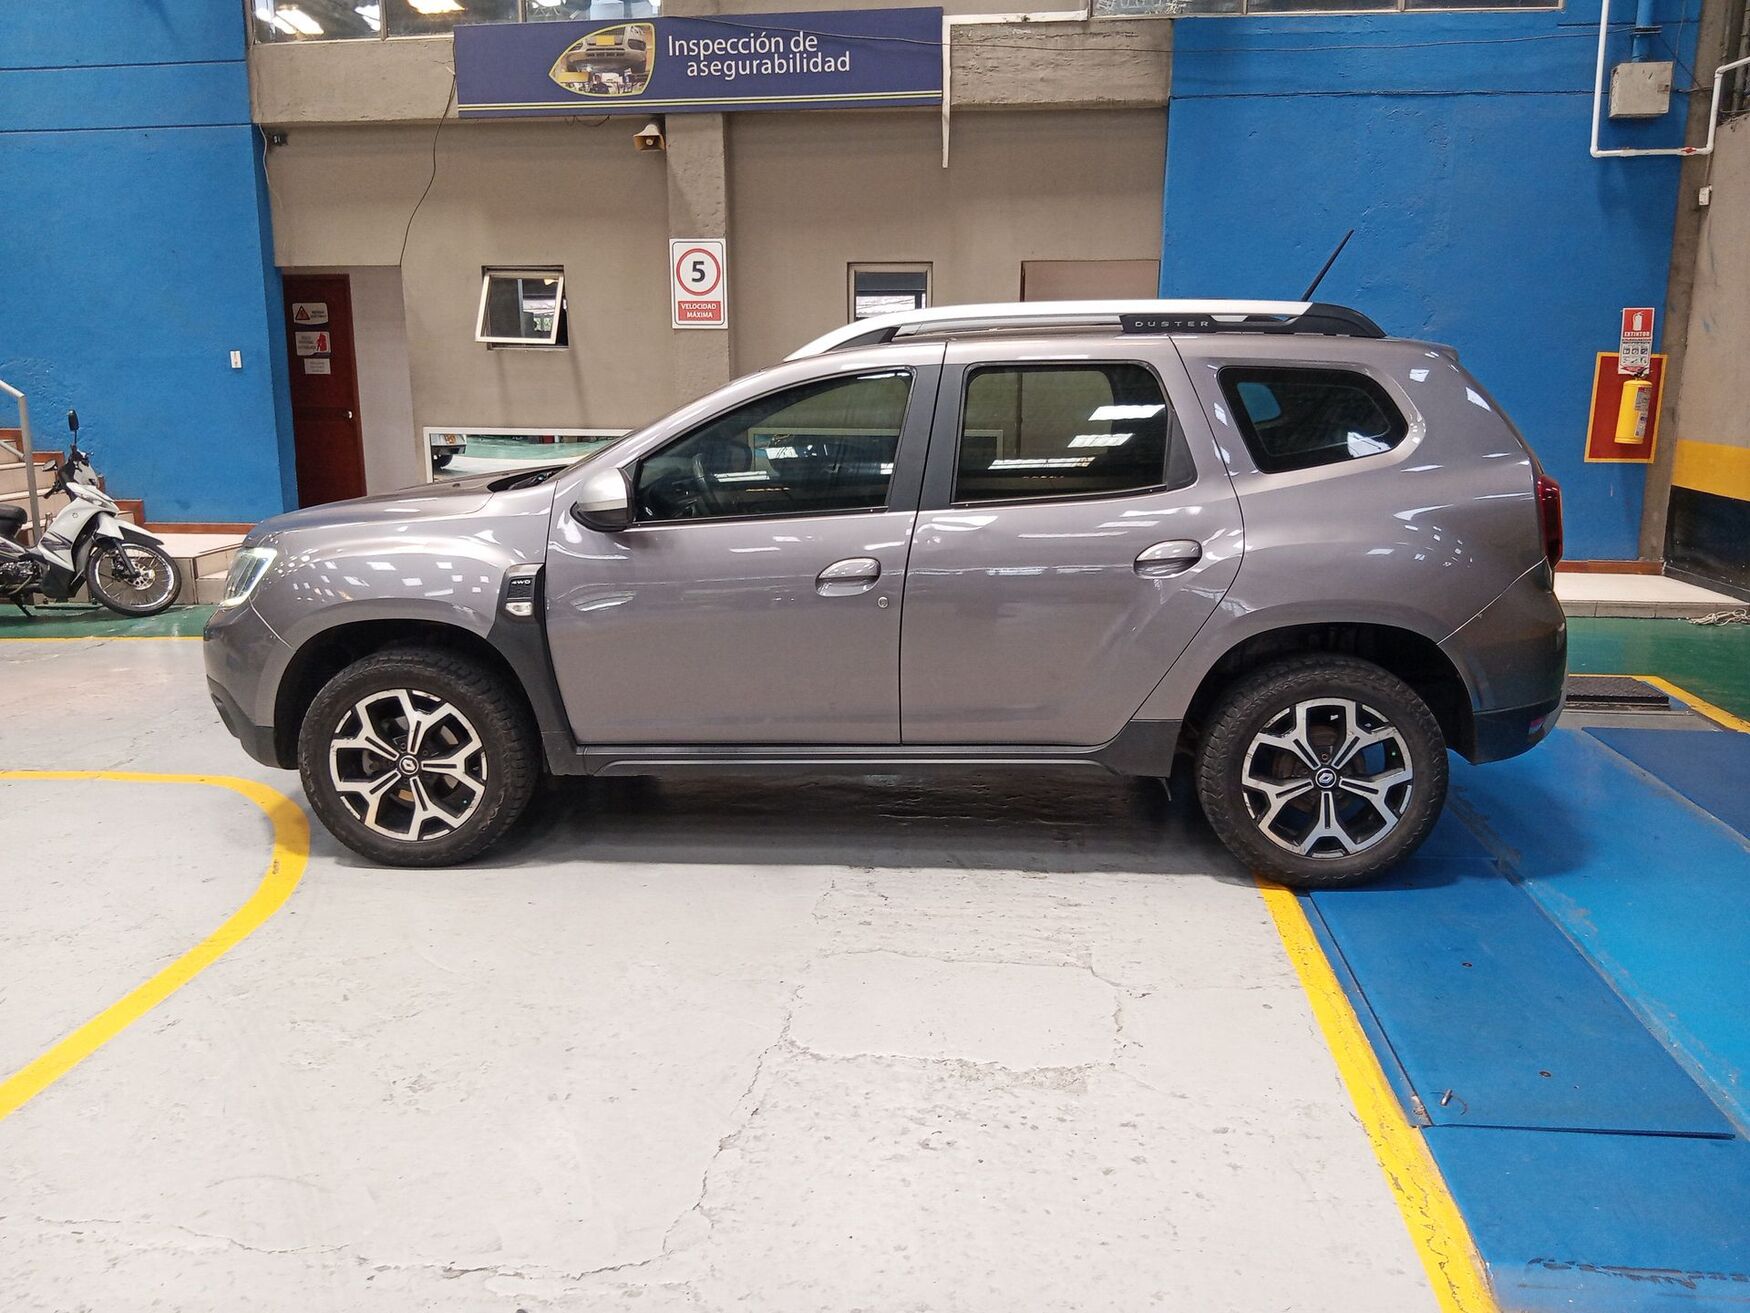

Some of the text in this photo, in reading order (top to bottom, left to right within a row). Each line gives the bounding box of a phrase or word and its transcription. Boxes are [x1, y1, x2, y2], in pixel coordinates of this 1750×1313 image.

[668, 30, 818, 60] Inspección de
[687, 51, 850, 80] asegurabilidad
[691, 261, 706, 283] 5
